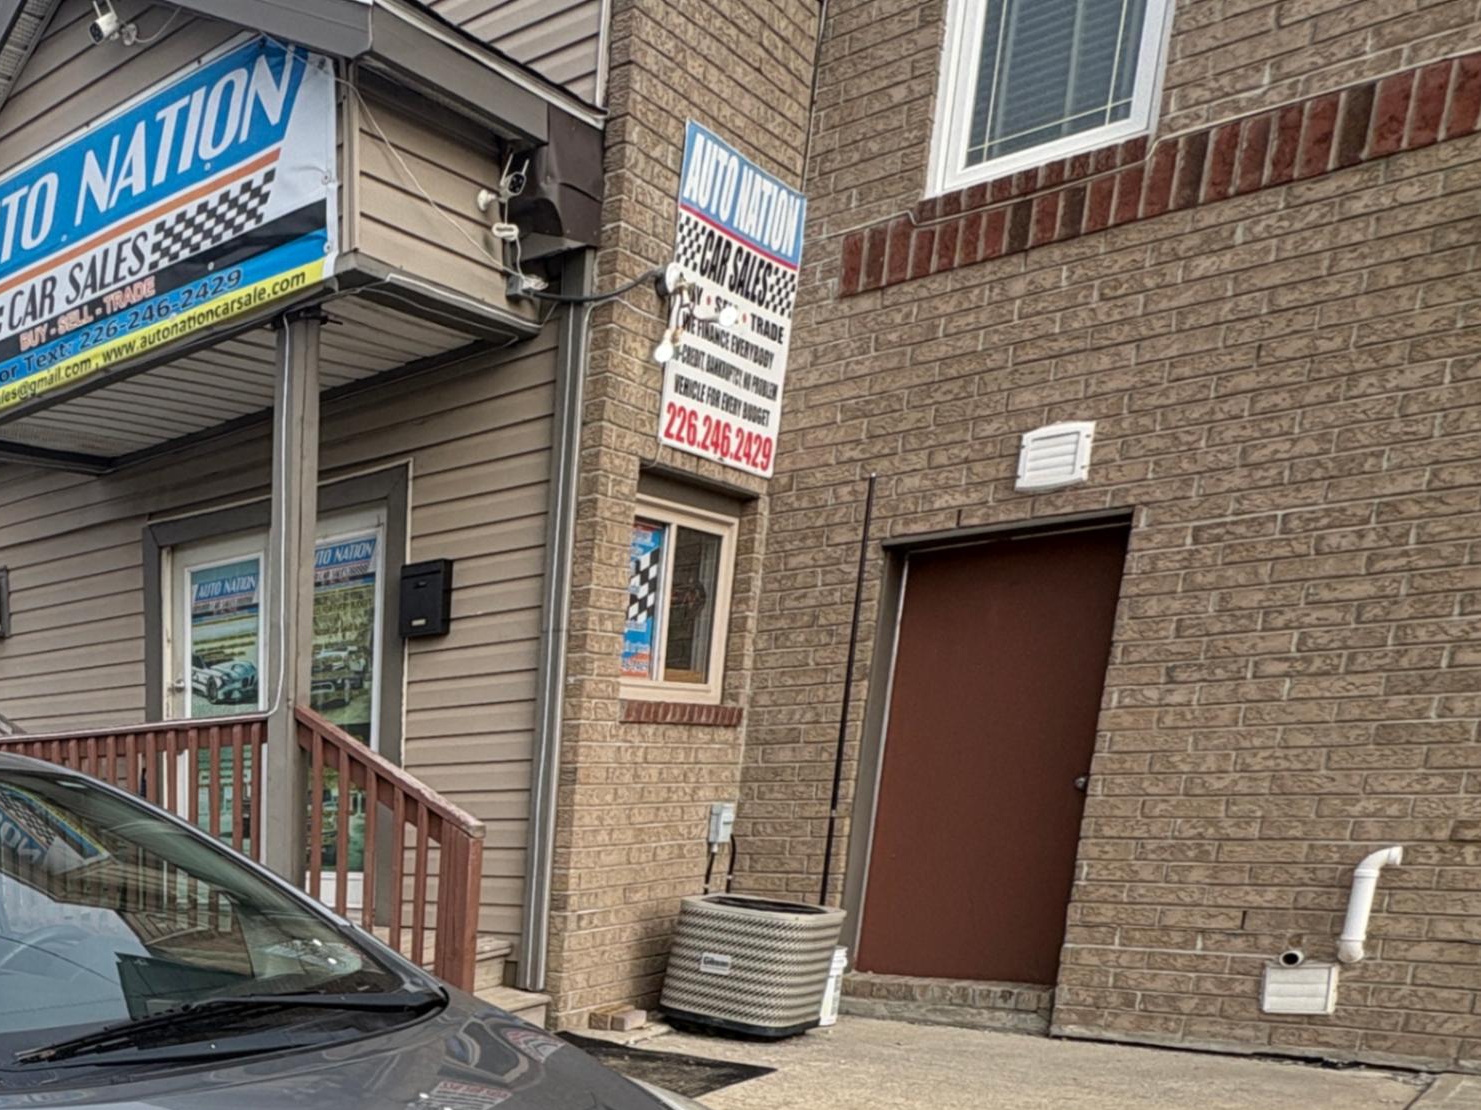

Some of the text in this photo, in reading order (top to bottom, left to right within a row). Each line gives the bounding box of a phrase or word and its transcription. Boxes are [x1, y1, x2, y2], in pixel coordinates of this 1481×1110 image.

[74, 44, 295, 228] NATION
[683, 132, 801, 258] AUTO NATION
[8, 231, 149, 331] CAR SALES
[700, 229, 773, 307] CAR SALES
[0, 365, 17, 382] or
[24, 343, 71, 374] Text:
[79, 269, 241, 348] 226-246-2429
[20, 276, 156, 351] BUY SELL TRADE
[102, 271, 306, 364] www.autonationcarsale.com
[697, 319, 730, 350] FINANCE
[731, 335, 774, 370] EVERYBODY
[751, 312, 784, 344] TRADE
[663, 401, 773, 471] 226.246.2429
[199, 576, 255, 598] AUTO NATION
[335, 541, 375, 562] NATION
